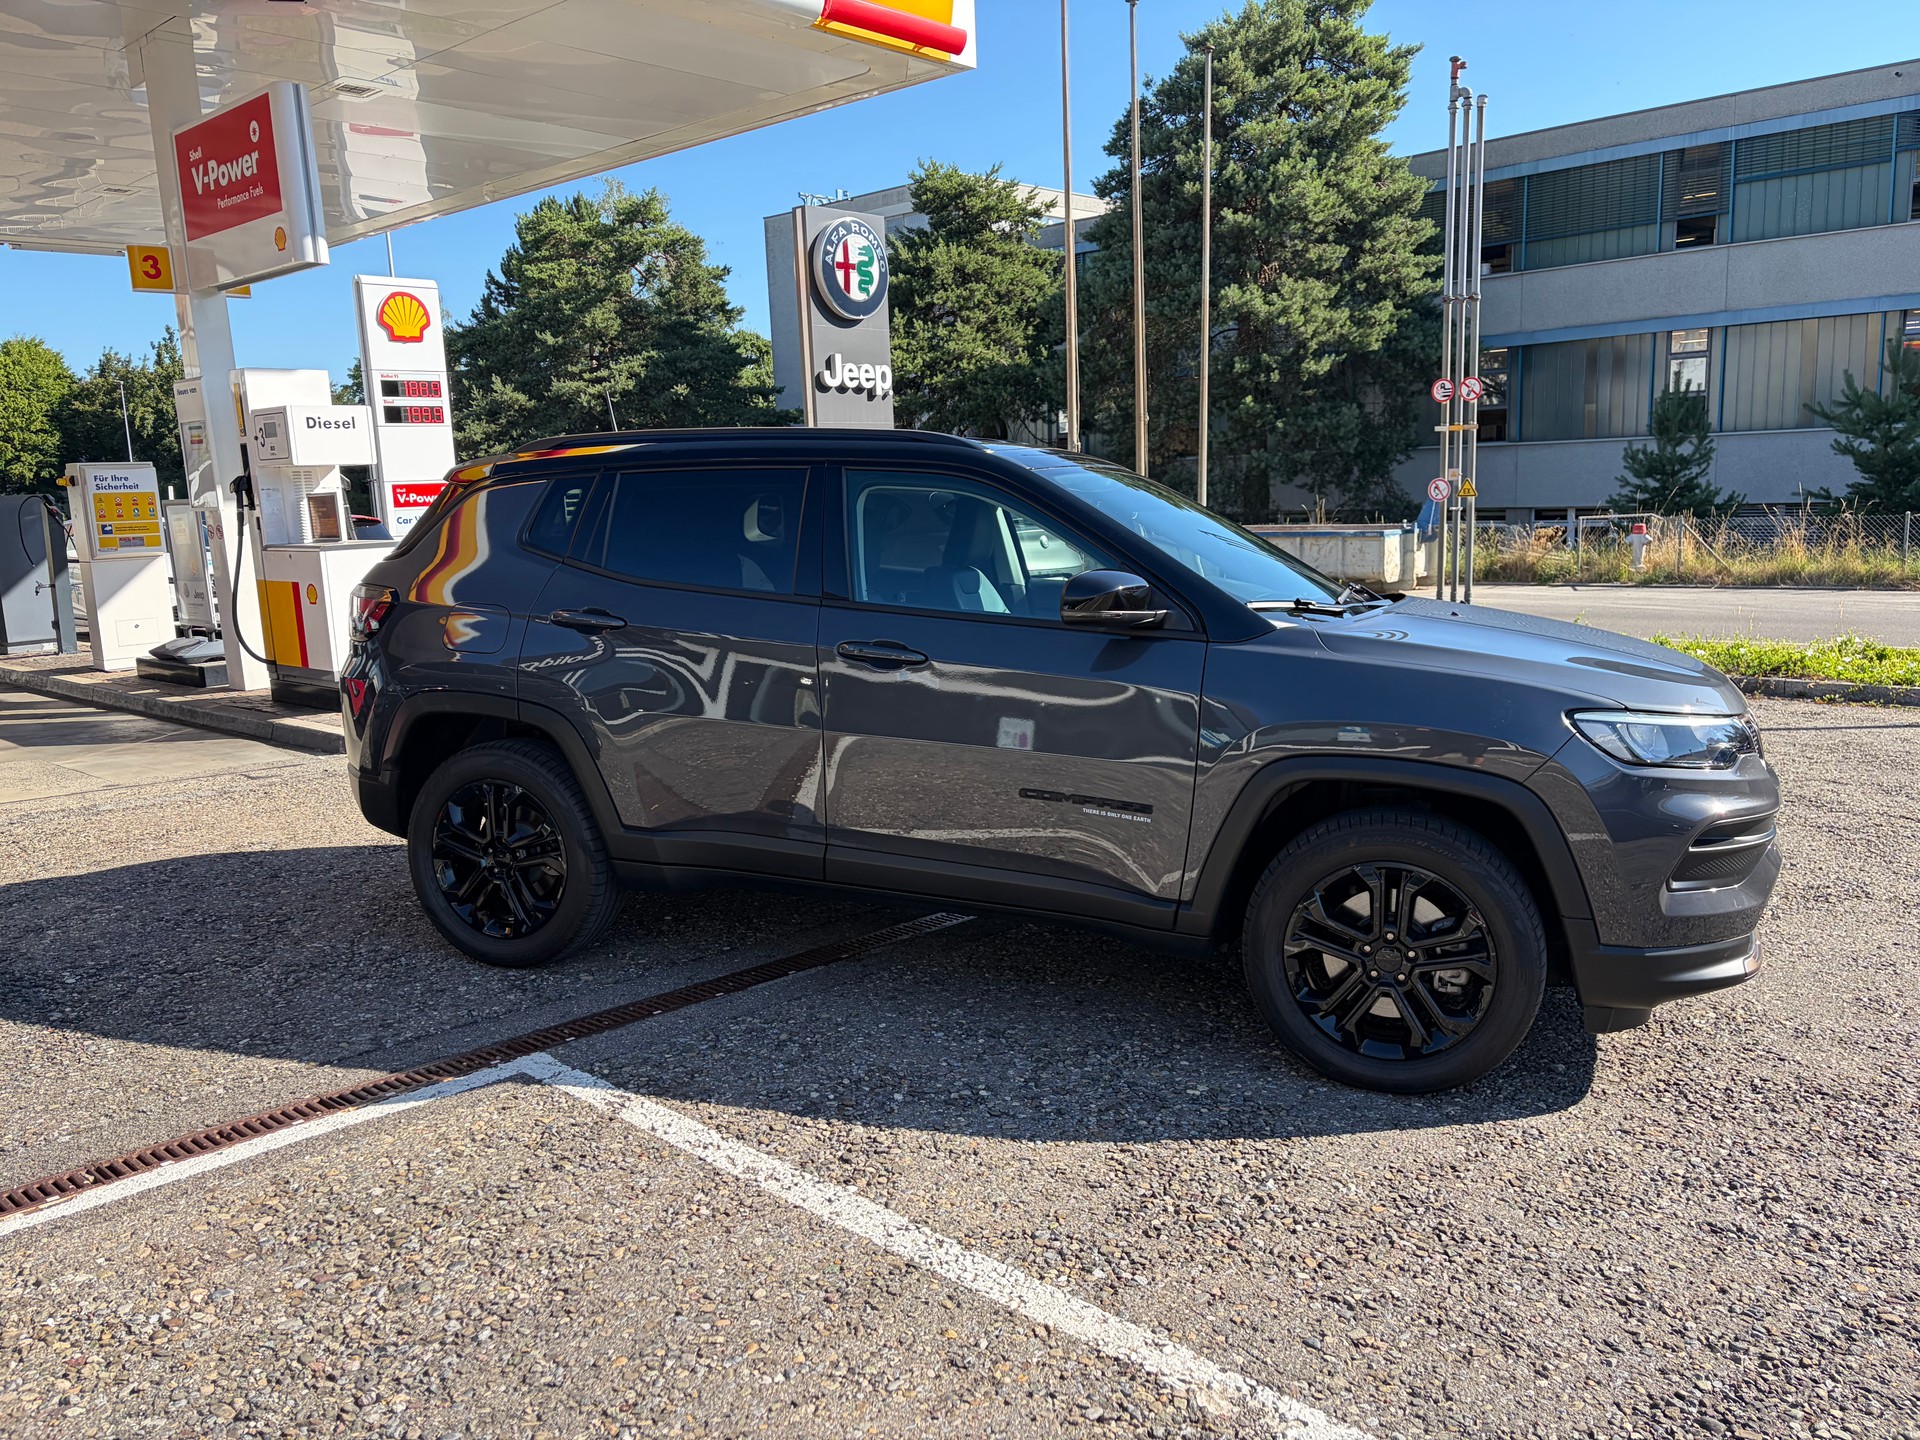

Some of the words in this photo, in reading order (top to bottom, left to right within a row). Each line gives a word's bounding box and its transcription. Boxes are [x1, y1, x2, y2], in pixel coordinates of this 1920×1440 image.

[189, 146, 203, 162] Shell
[191, 150, 259, 195] V-Power
[217, 188, 250, 210] Performance
[250, 182, 264, 200] Fuels
[825, 224, 848, 266] ALFA
[851, 221, 886, 273] ROMEO
[142, 254, 162, 280] 3
[823, 352, 894, 396] Jeep
[305, 416, 356, 429] Diesel
[258, 427, 266, 448] 3
[93, 474, 109, 482] Für
[110, 474, 129, 482] Ihre
[95, 483, 139, 491] Sicherheit
[397, 493, 438, 504] V-Pow
[396, 516, 413, 525] Car
[1082, 807, 1100, 816] THERE
[1107, 811, 1121, 819] ONLY
[1133, 815, 1152, 824] EARTH
